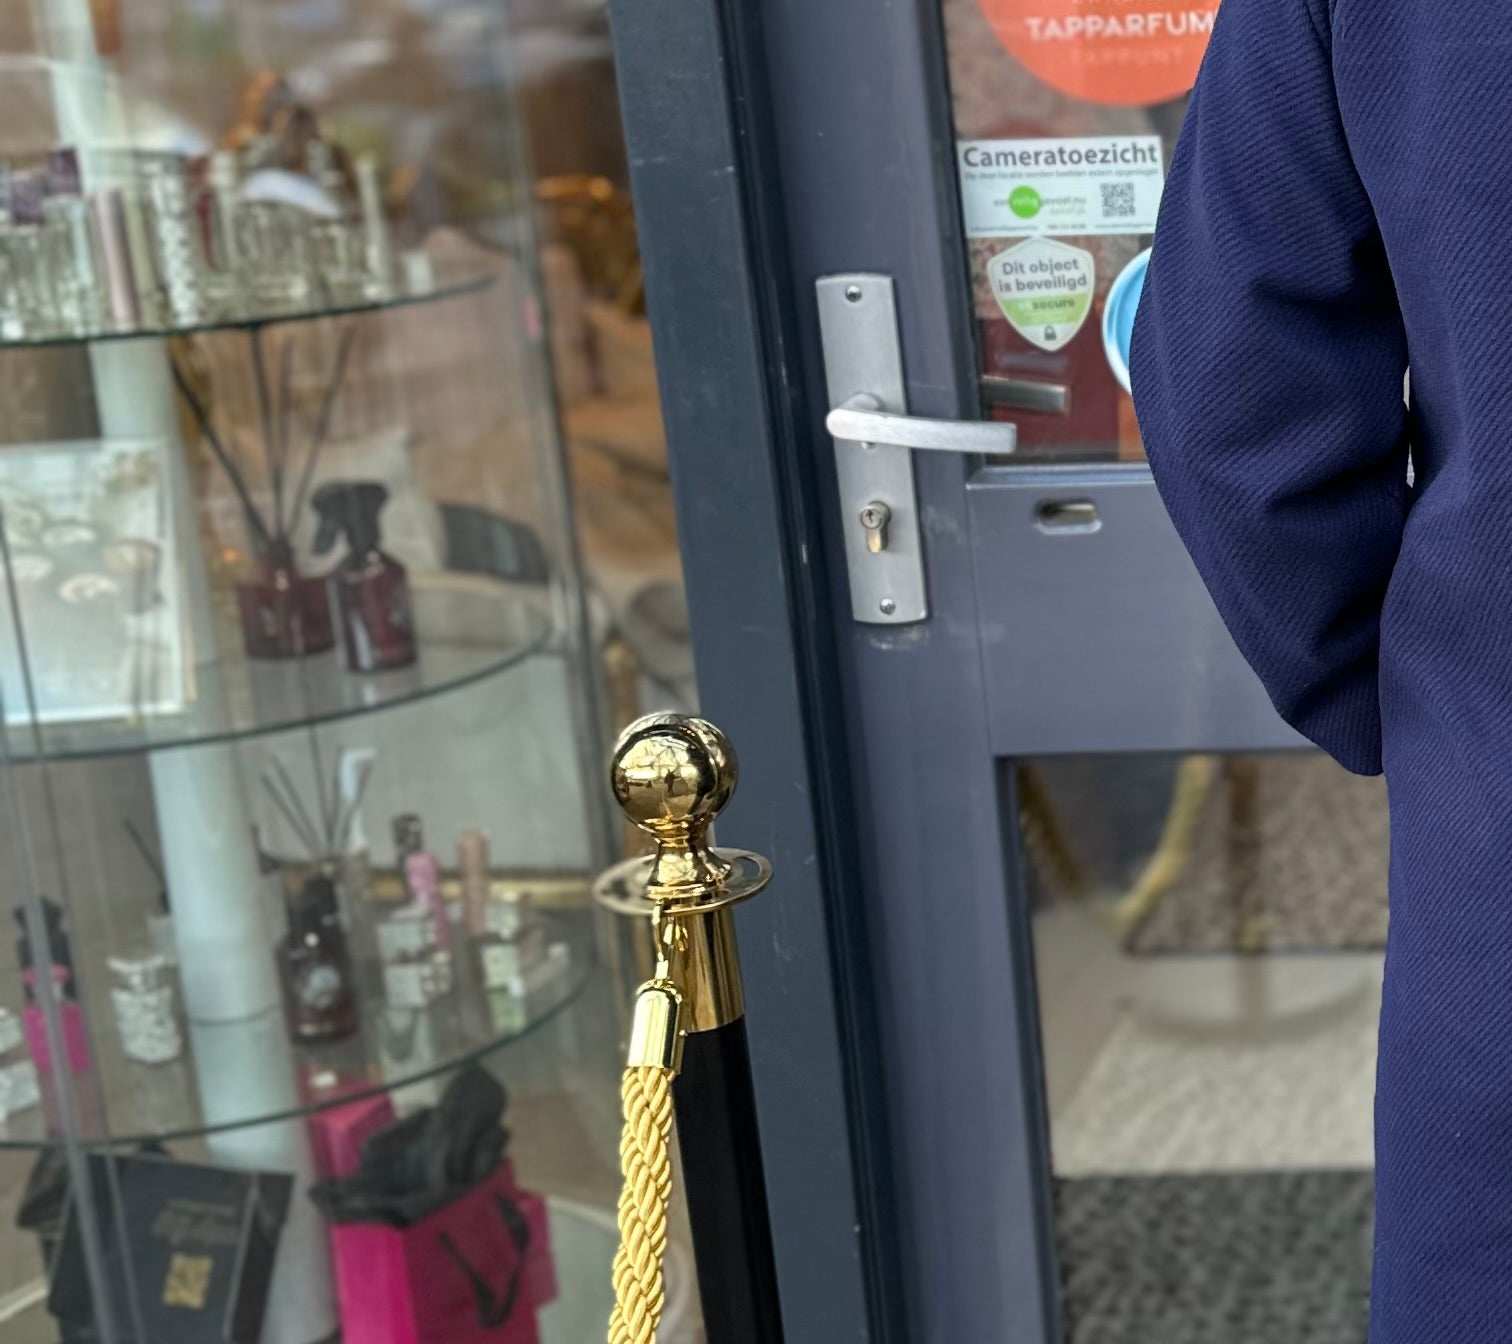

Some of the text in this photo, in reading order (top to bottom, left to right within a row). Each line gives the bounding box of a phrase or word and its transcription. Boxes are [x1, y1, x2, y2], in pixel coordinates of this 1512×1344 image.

[1025, 10, 1215, 42] TAPPARFUM
[963, 142, 1158, 168] Cameratoezicht
[1002, 258, 1079, 275] Dit object
[998, 273, 1087, 292] is beveiligd
